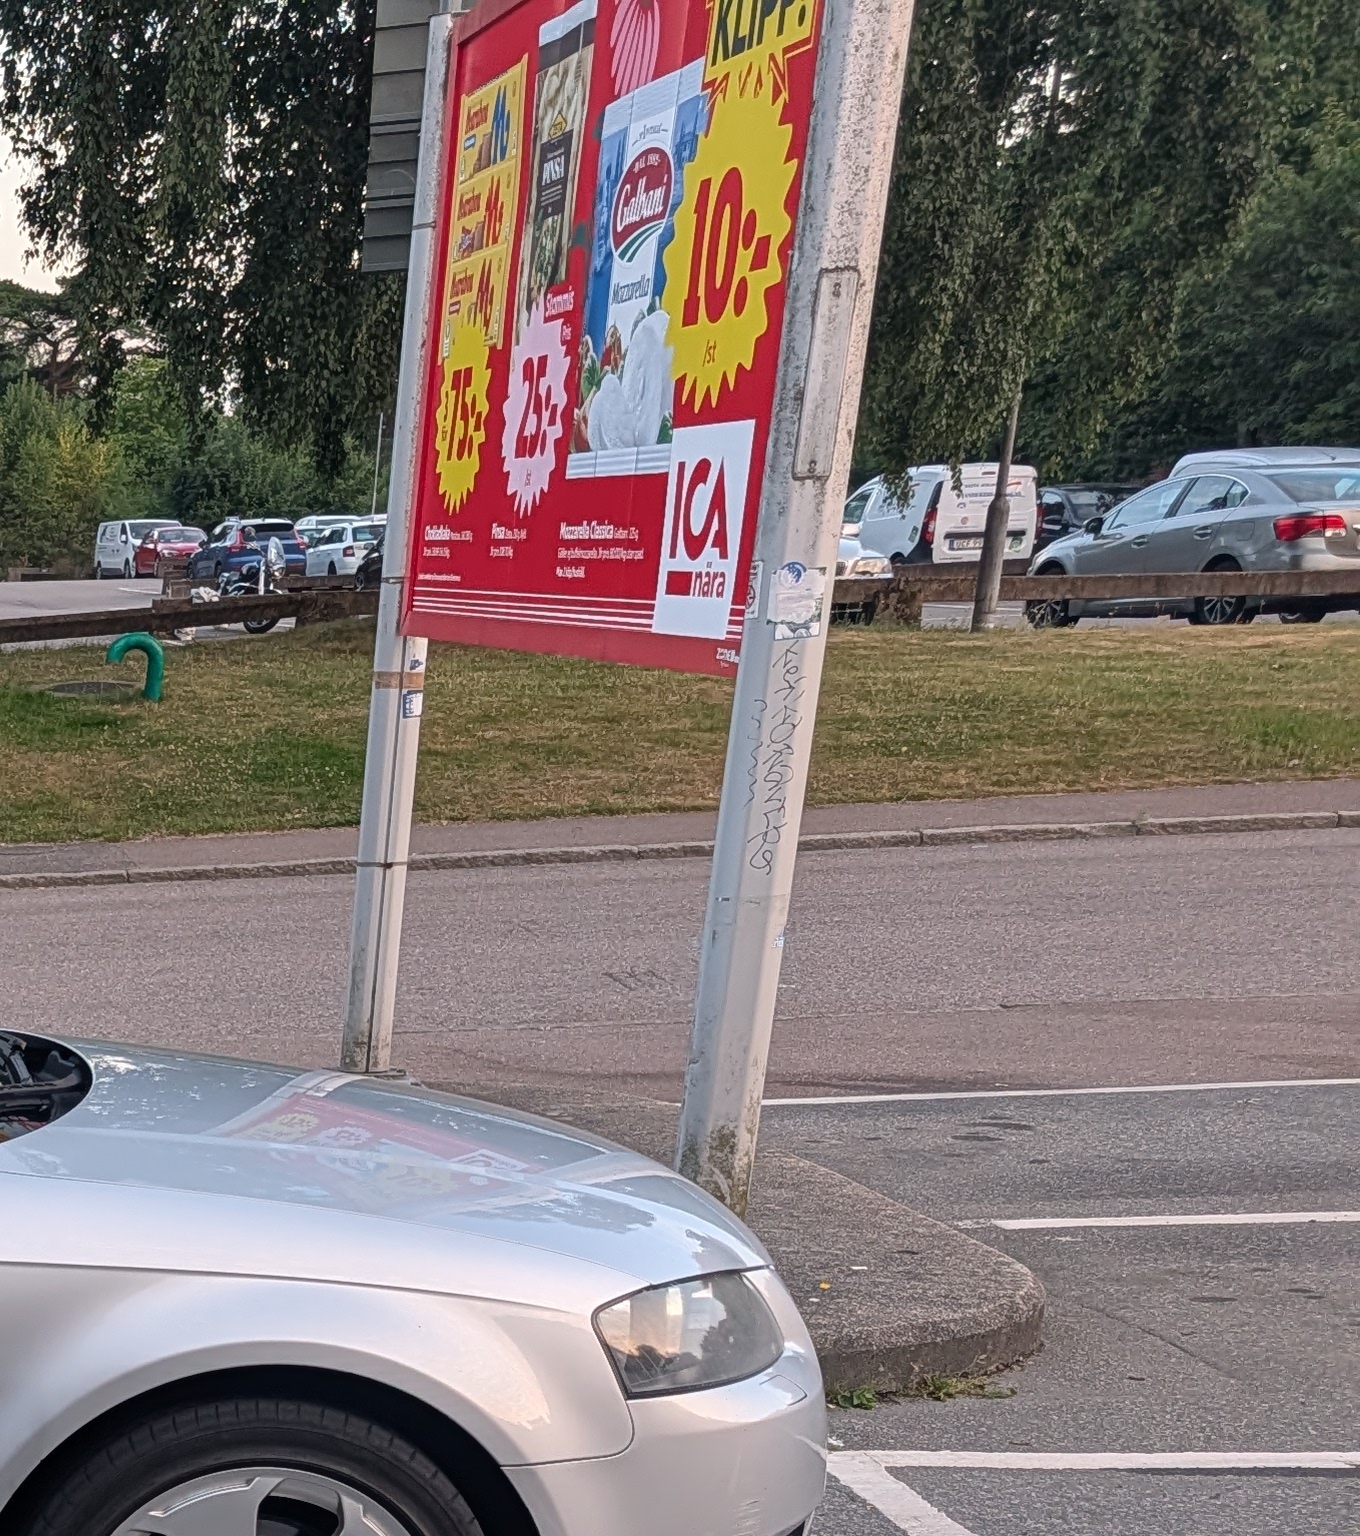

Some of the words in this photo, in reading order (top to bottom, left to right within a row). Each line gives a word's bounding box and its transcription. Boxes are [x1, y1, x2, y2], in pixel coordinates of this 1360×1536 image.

[710, 0, 806, 67] KLIPP
[616, 174, 668, 233] Galbani
[669, 456, 729, 561] ICA
[692, 561, 726, 599] nära
